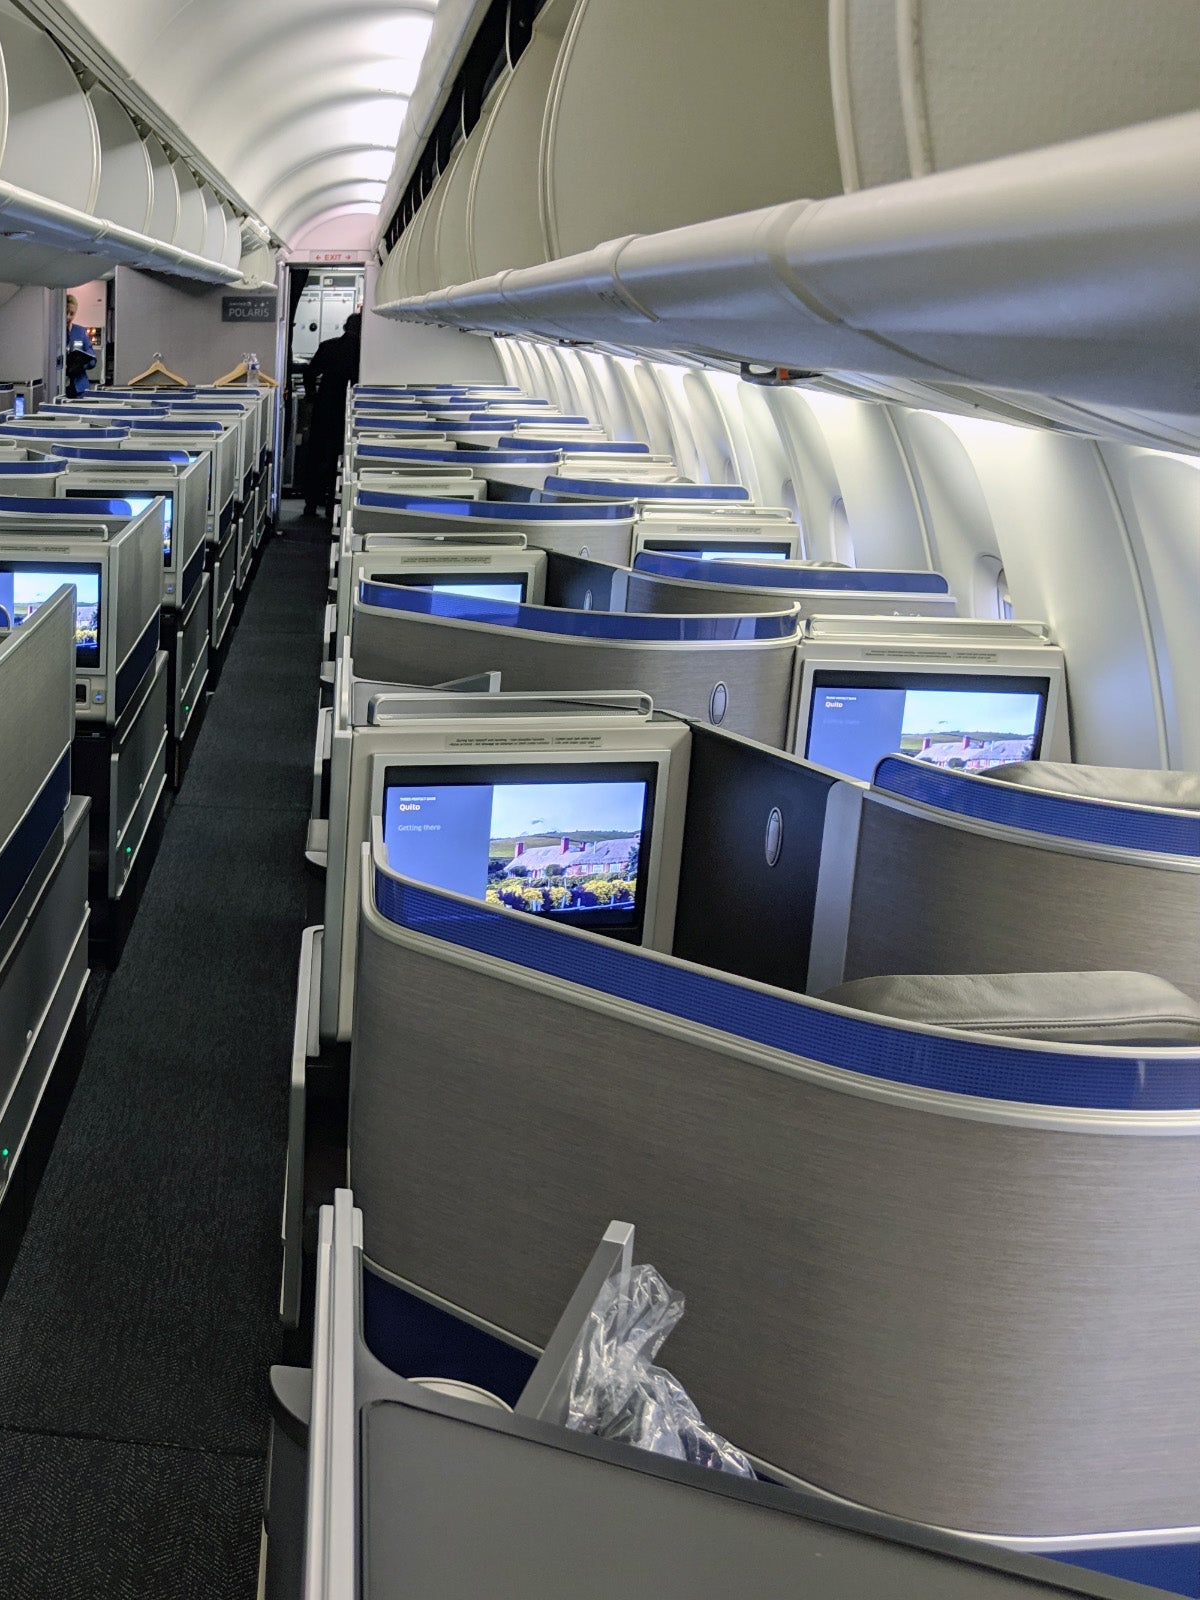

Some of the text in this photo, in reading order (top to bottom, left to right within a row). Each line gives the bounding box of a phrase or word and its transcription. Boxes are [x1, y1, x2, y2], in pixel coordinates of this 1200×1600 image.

[229, 308, 270, 318] POLARIS
[400, 803, 421, 811] Quito
[398, 824, 422, 832] Getting
